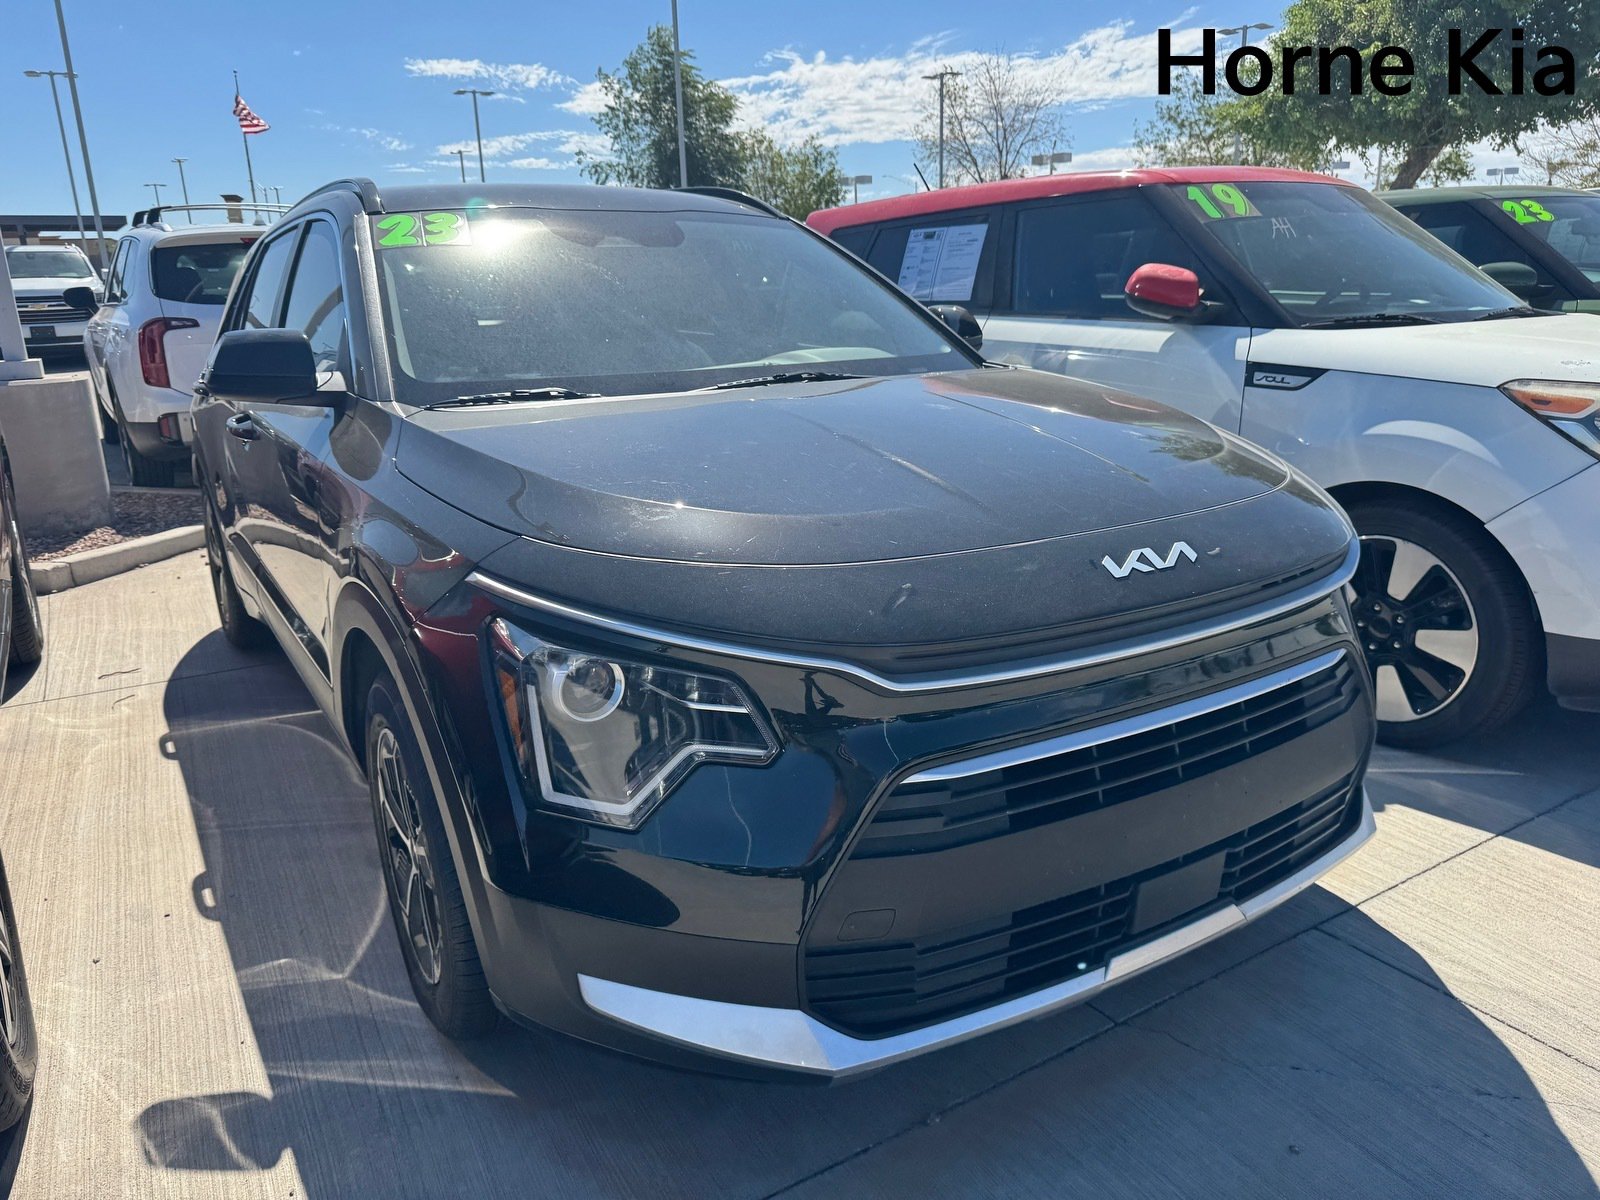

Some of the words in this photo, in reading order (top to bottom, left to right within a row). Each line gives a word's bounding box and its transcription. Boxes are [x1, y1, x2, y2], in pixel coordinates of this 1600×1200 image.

[1187, 184, 1248, 219] 19
[1502, 199, 1554, 225] 23
[376, 212, 461, 246] 23
[1101, 541, 1198, 578] KIA
